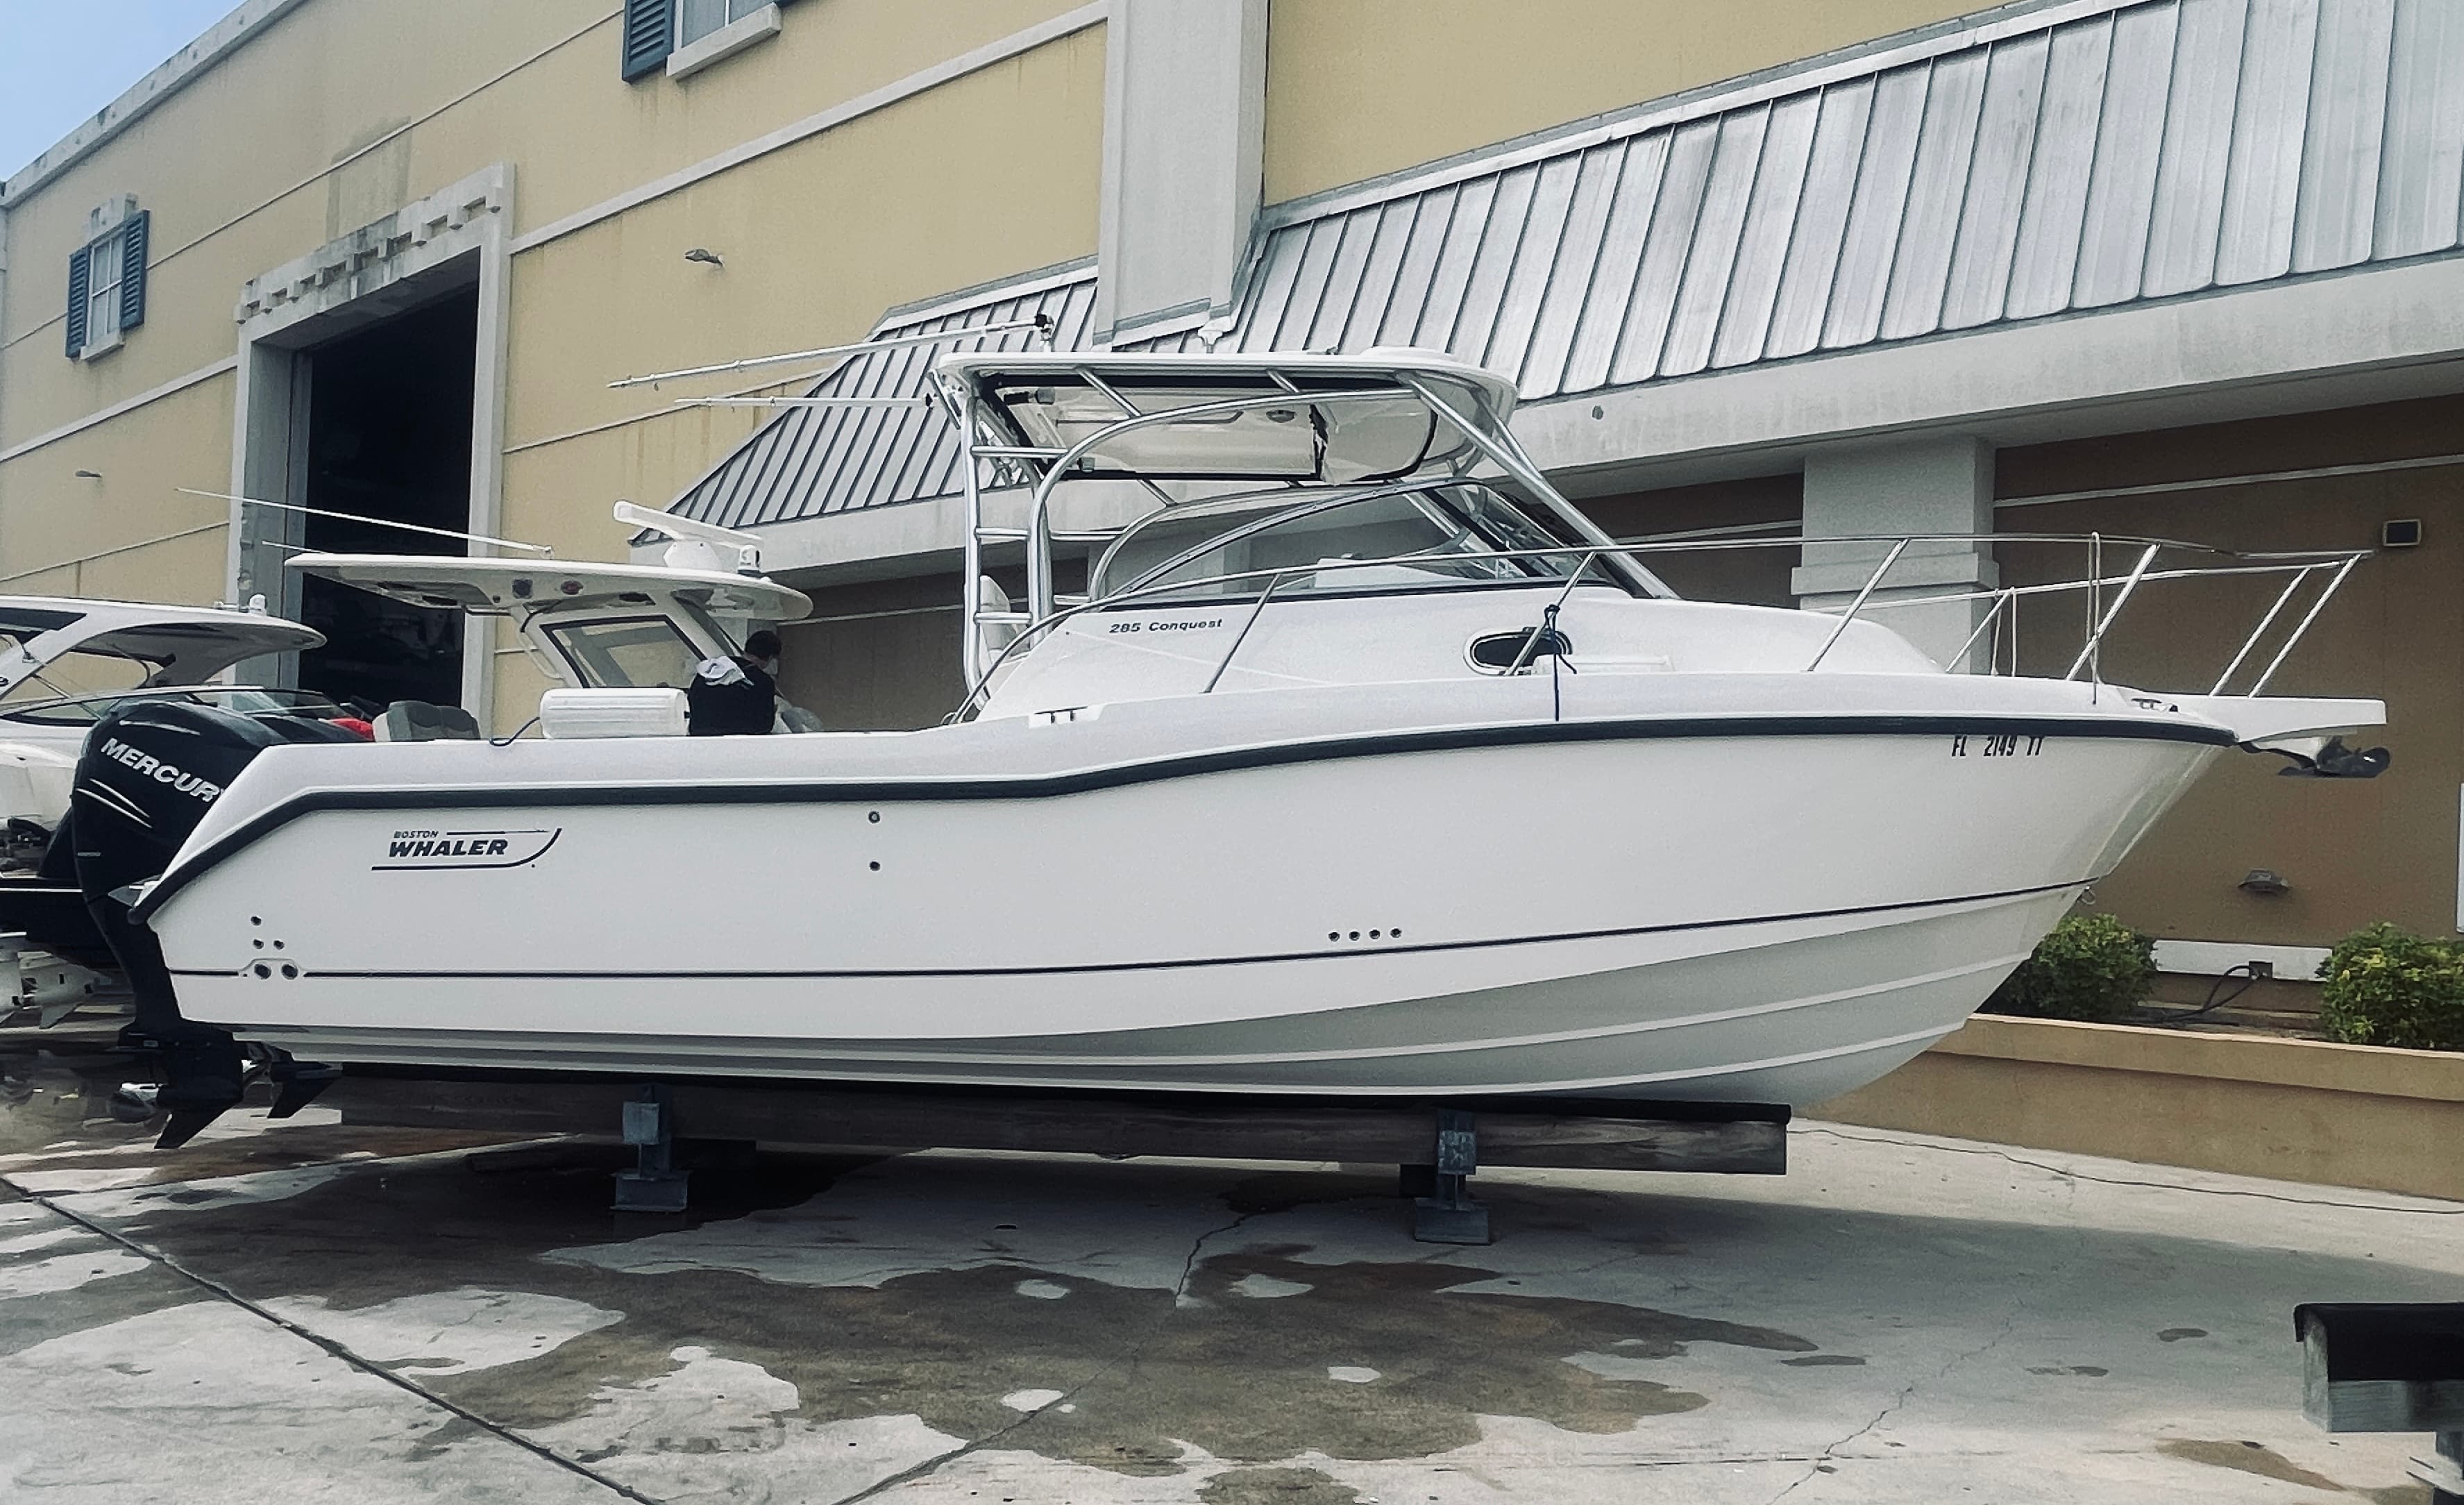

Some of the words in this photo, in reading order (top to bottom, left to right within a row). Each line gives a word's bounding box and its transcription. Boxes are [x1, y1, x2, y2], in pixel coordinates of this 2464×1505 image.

[1109, 623, 1141, 633] 285
[1149, 619, 1222, 631] Conquest
[1952, 735, 1967, 757] FL
[1983, 734, 2018, 757] 2149
[101, 737, 225, 802] MERCUR
[394, 830, 439, 839] BOSTON
[389, 839, 508, 857] WHALER
